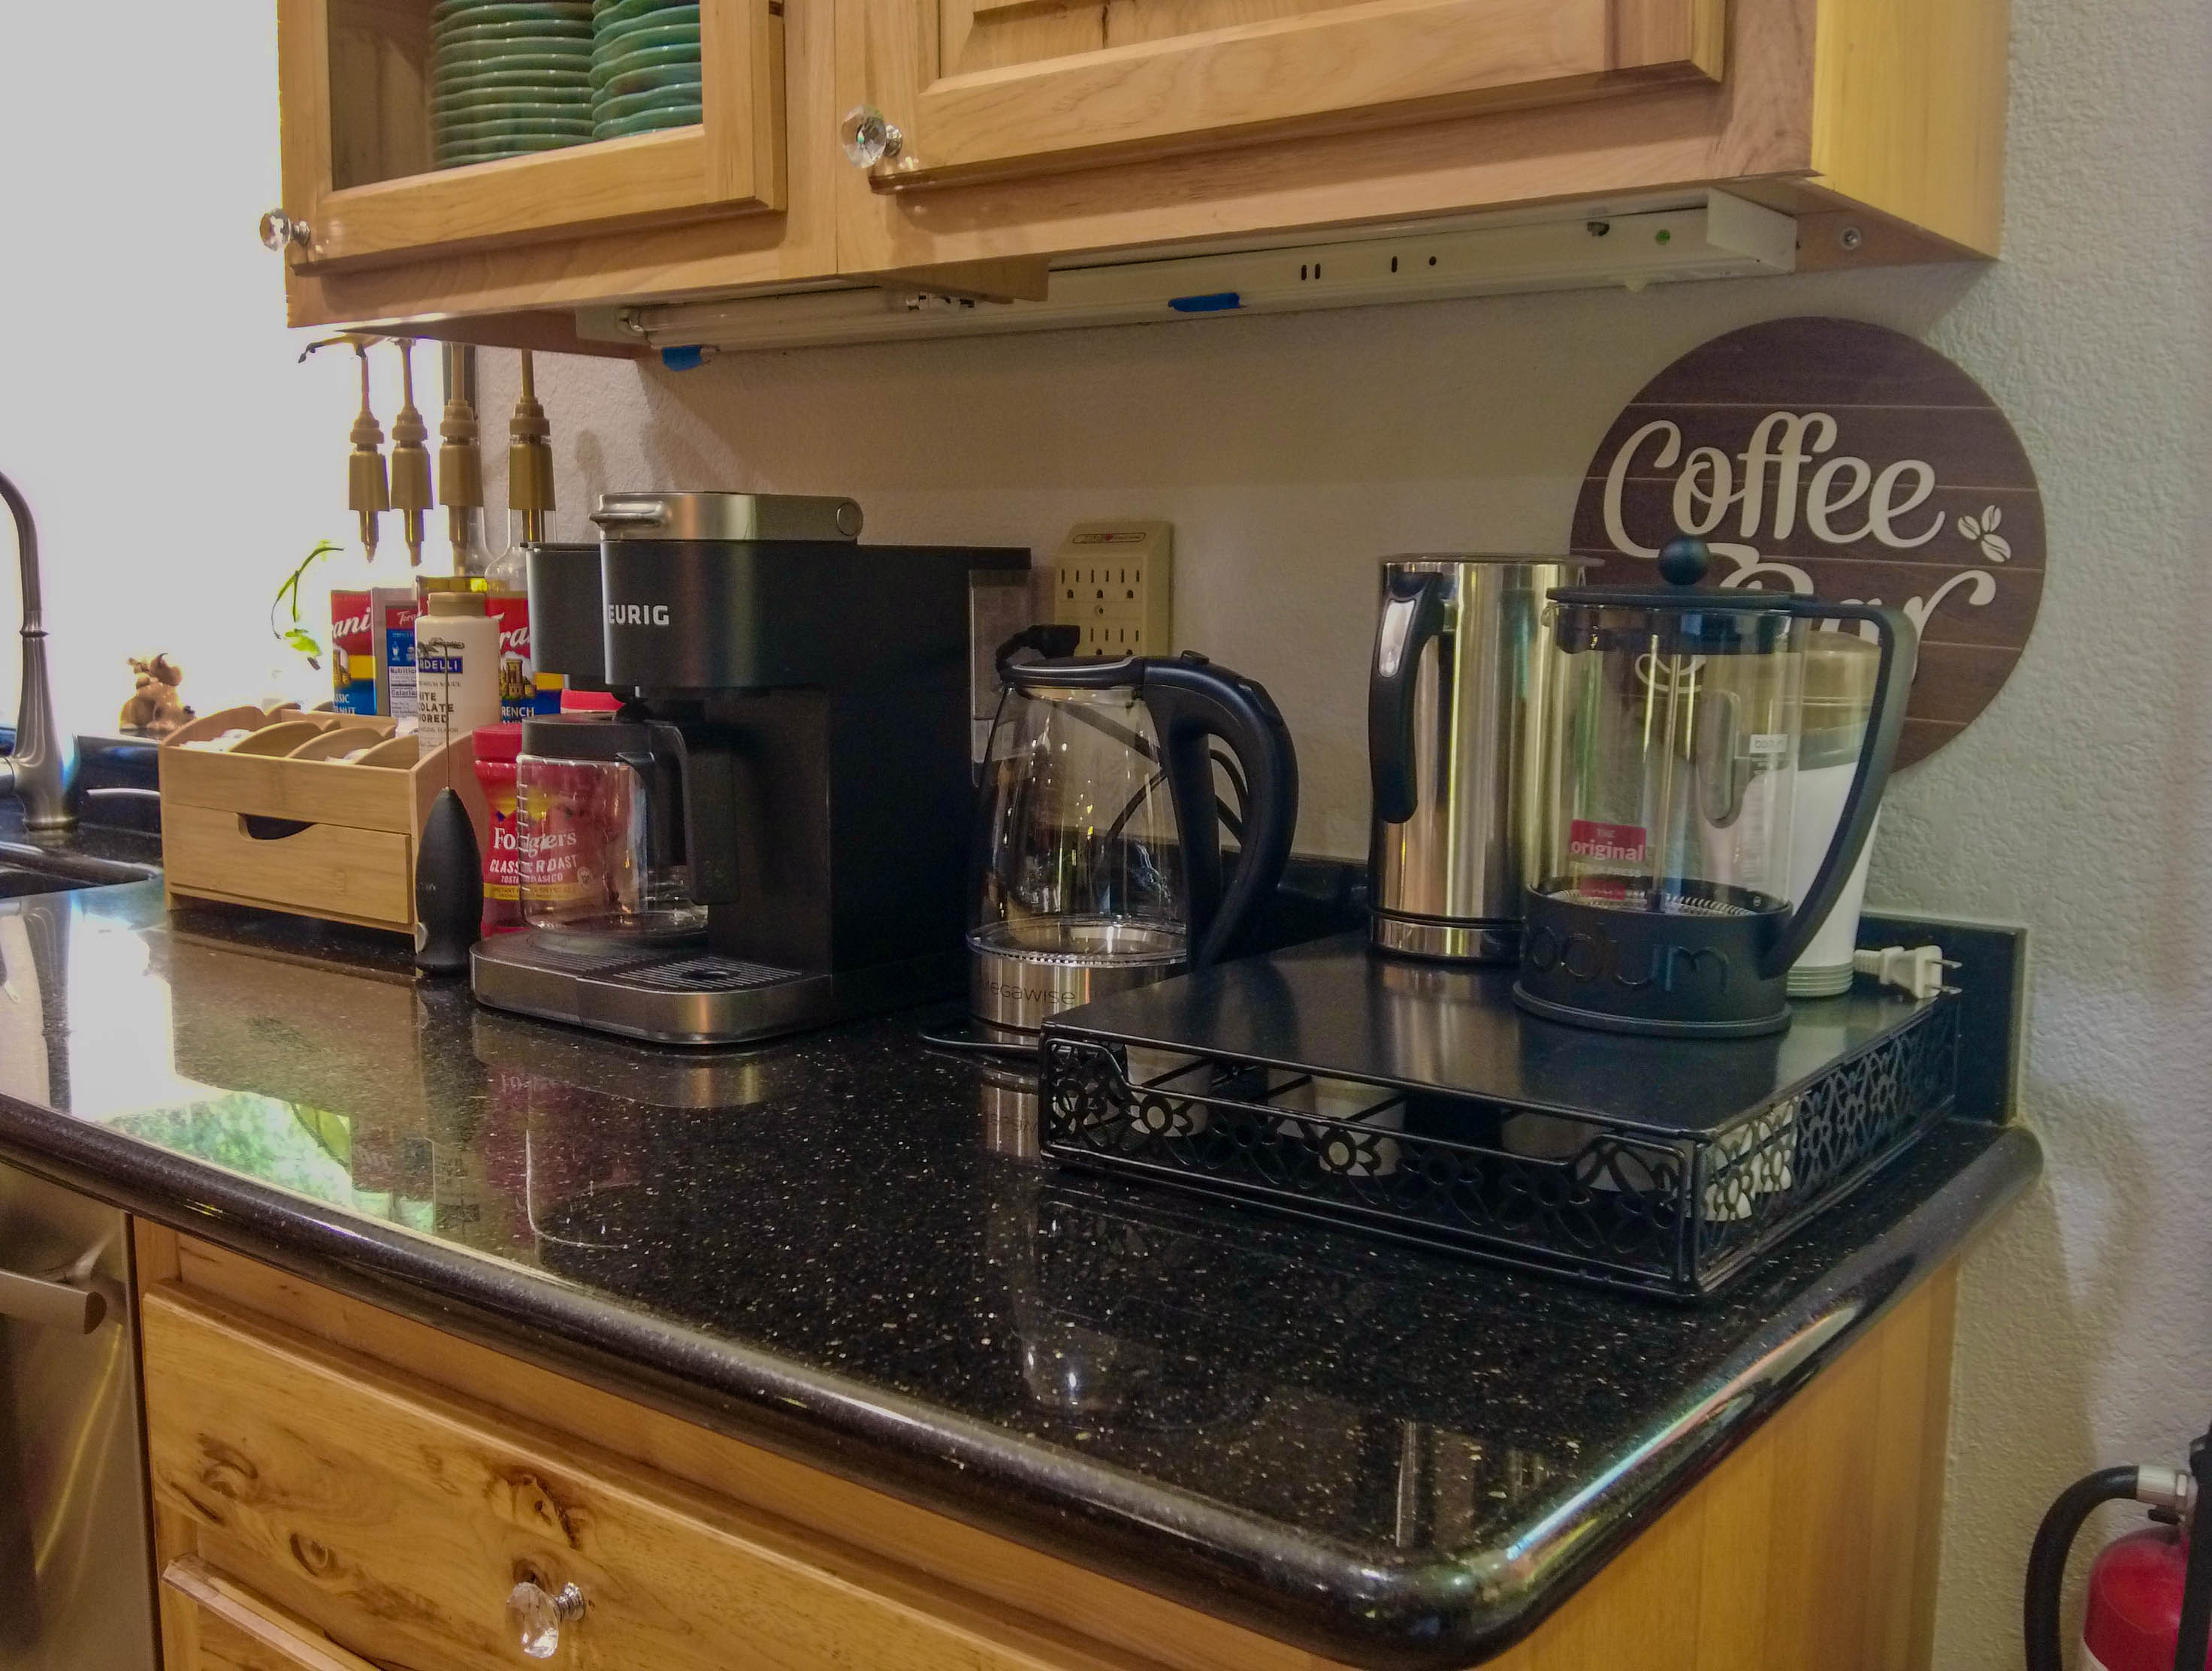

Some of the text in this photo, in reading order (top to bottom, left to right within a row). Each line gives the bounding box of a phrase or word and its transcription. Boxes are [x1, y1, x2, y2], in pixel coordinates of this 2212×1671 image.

[1603, 411, 1945, 559] Coffee
[608, 604, 669, 625] EURIG
[501, 706, 536, 718] RENCH
[1570, 839, 1644, 862] original
